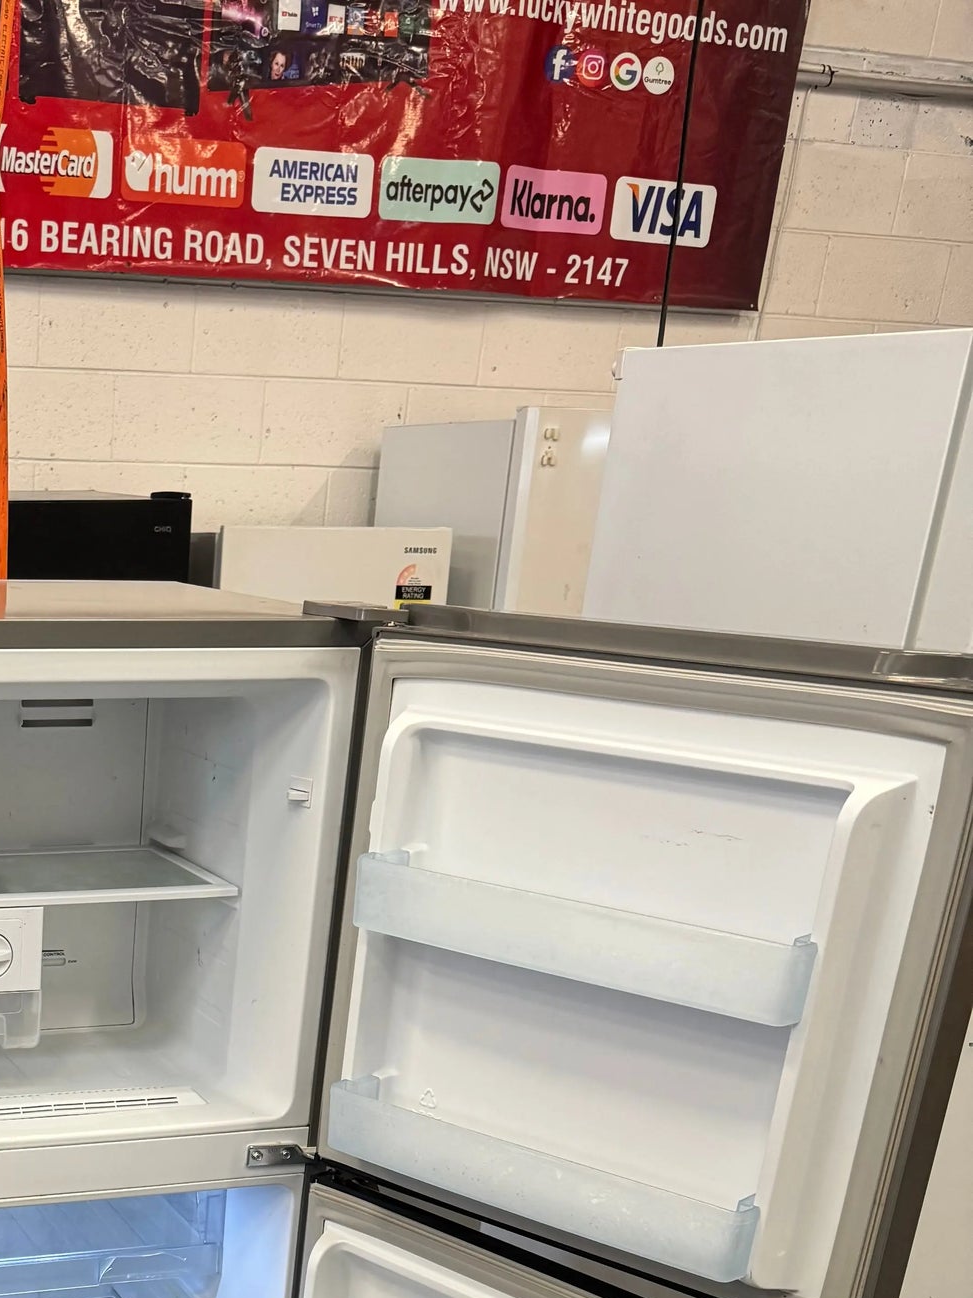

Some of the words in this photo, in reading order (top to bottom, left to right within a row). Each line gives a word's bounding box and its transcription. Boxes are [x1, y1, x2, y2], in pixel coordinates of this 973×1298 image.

[644, 76, 672, 86] Gumtree
[1, 146, 96, 179] MasterCard
[154, 152, 237, 198] humm
[269, 159, 358, 184] AMERICAN
[280, 183, 358, 206] EXPRESS
[386, 175, 472, 212] afterpay
[510, 178, 596, 224] Klarna.
[626, 182, 704, 239] VISA
[40, 220, 173, 260] BEARING
[184, 229, 272, 271] ROAD,
[283, 235, 375, 271] SEVEN
[385, 241, 476, 281] HILLS,
[483, 246, 539, 282] NSW
[564, 254, 629, 287] 2147
[404, 546, 438, 554] SAMSUNG
